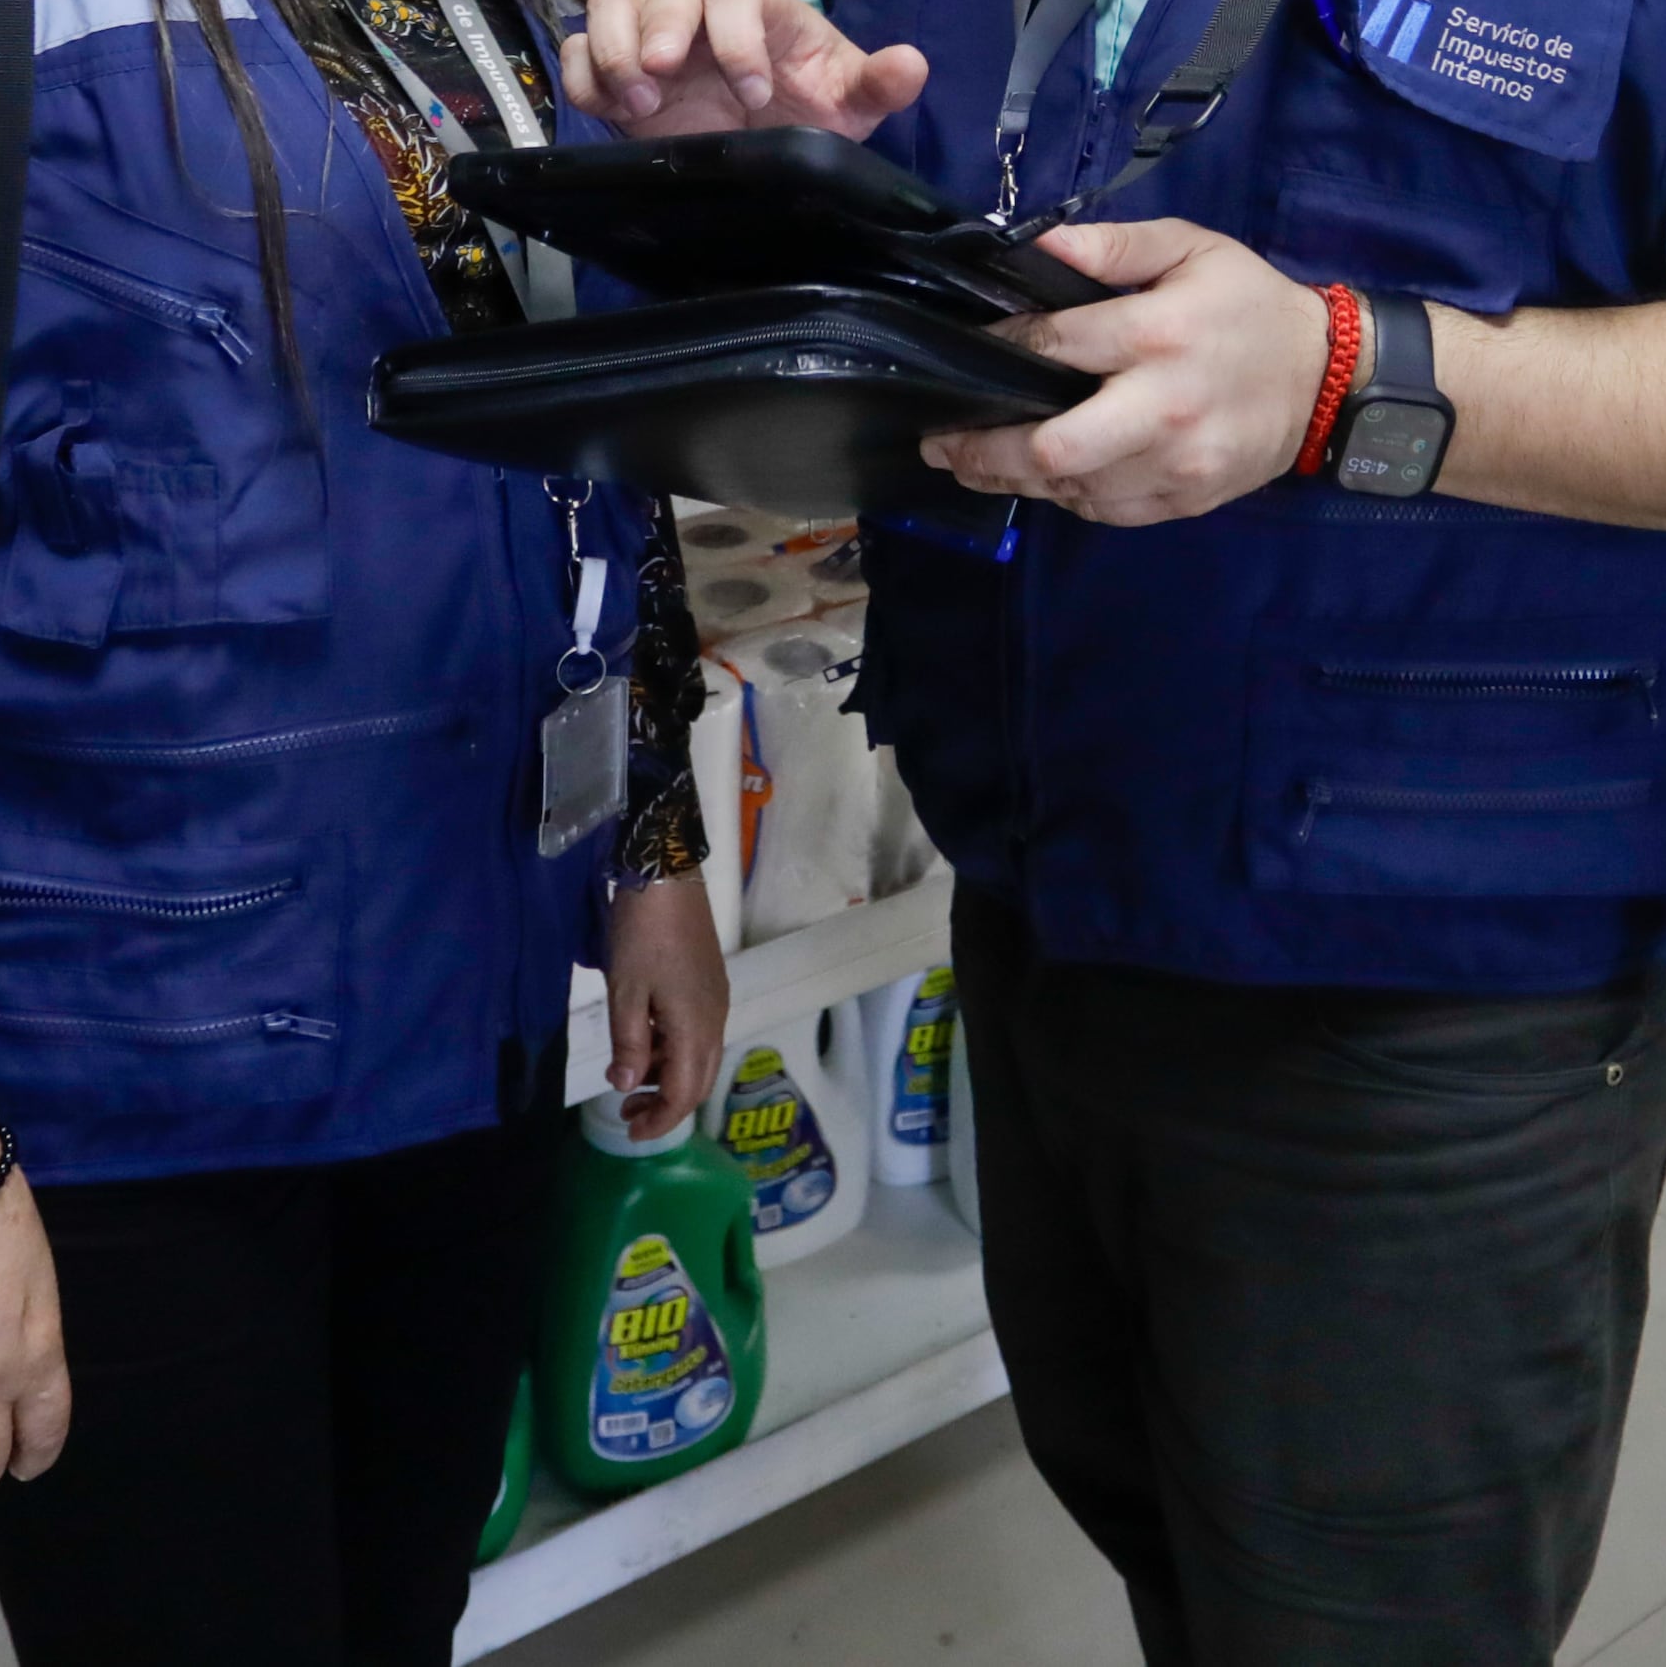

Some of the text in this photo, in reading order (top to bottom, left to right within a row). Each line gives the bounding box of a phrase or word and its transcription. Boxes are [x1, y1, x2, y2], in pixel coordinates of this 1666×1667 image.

[1437, 27, 1567, 85] Impuestos
[1446, 6, 1574, 60] Servicio de
[452, 3, 474, 29] de
[466, 33, 532, 136] Impuestos
[1431, 49, 1535, 102] Internos
[726, 1099, 798, 1142] BIO
[609, 1295, 690, 1347] BIO
